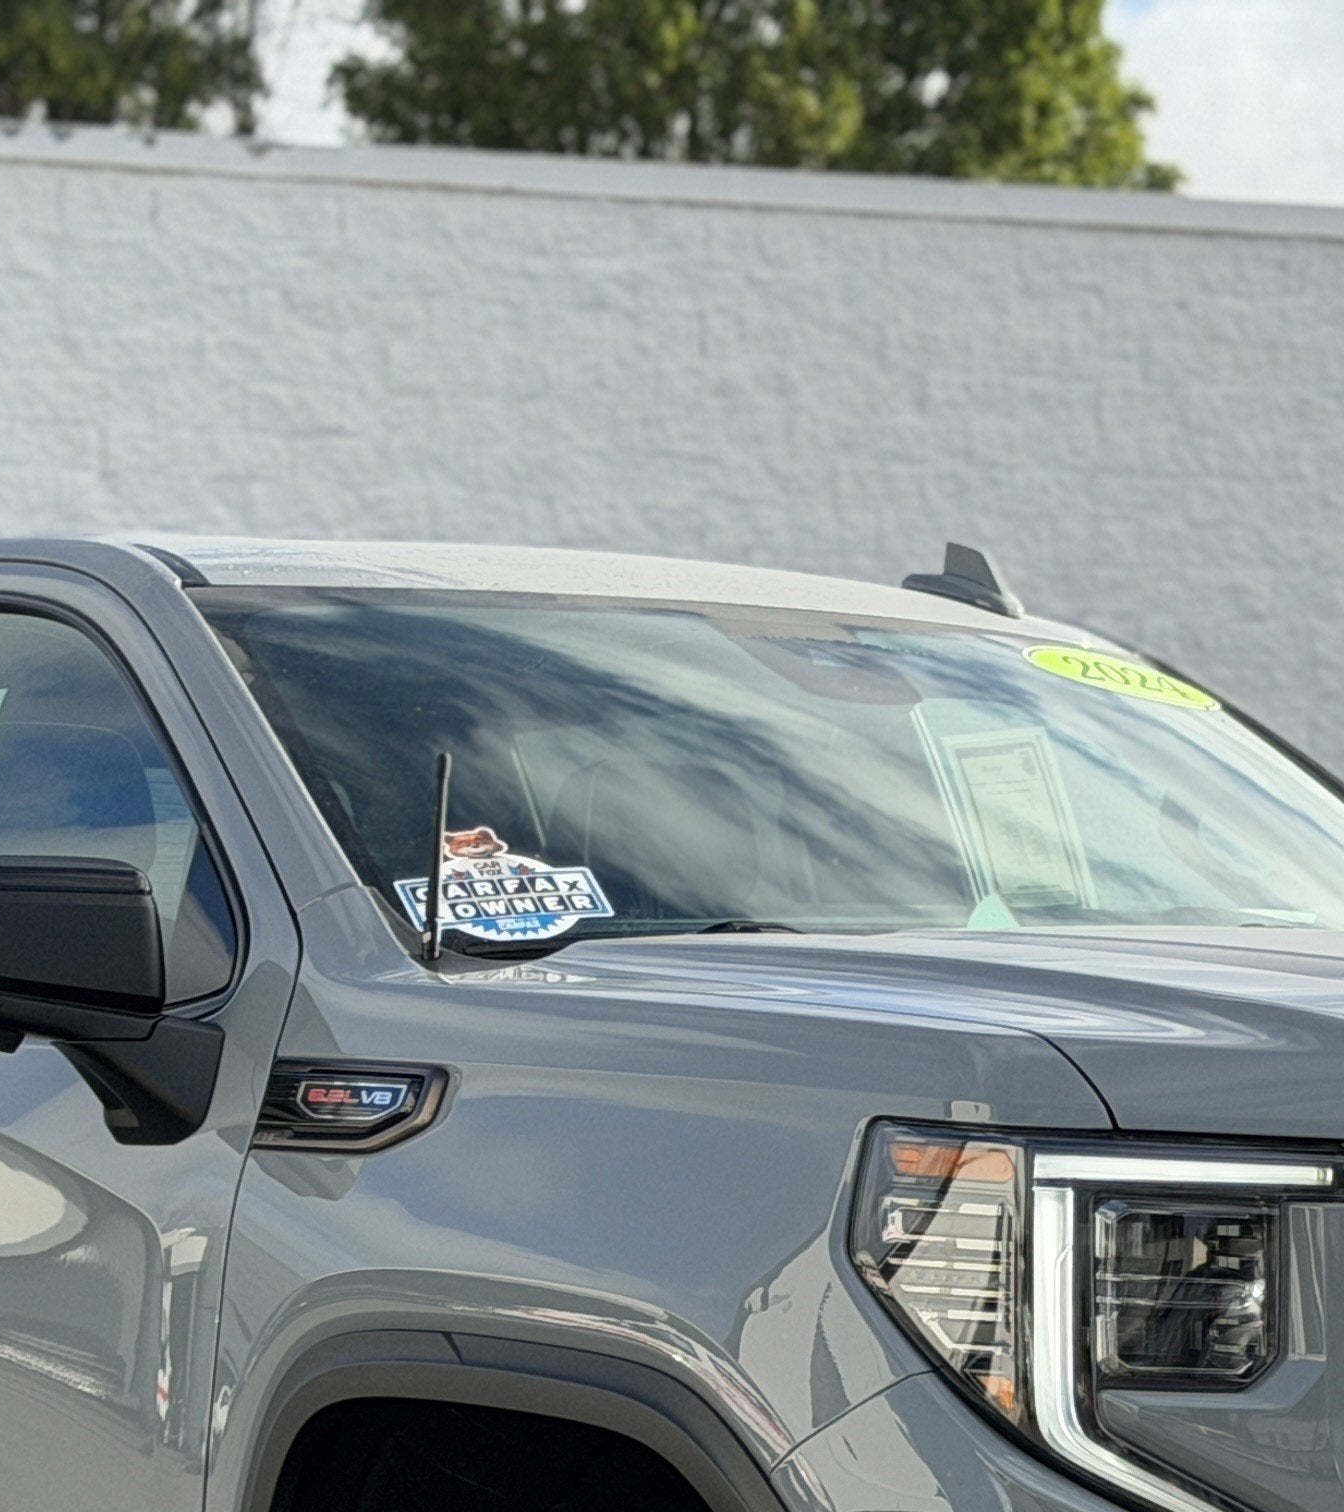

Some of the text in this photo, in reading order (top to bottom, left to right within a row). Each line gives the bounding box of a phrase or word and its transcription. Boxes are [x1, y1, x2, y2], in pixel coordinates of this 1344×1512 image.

[472, 860, 501, 870] CAR
[478, 868, 506, 877] FOX
[455, 894, 594, 919] OWNER
[360, 1089, 393, 1105] V8
